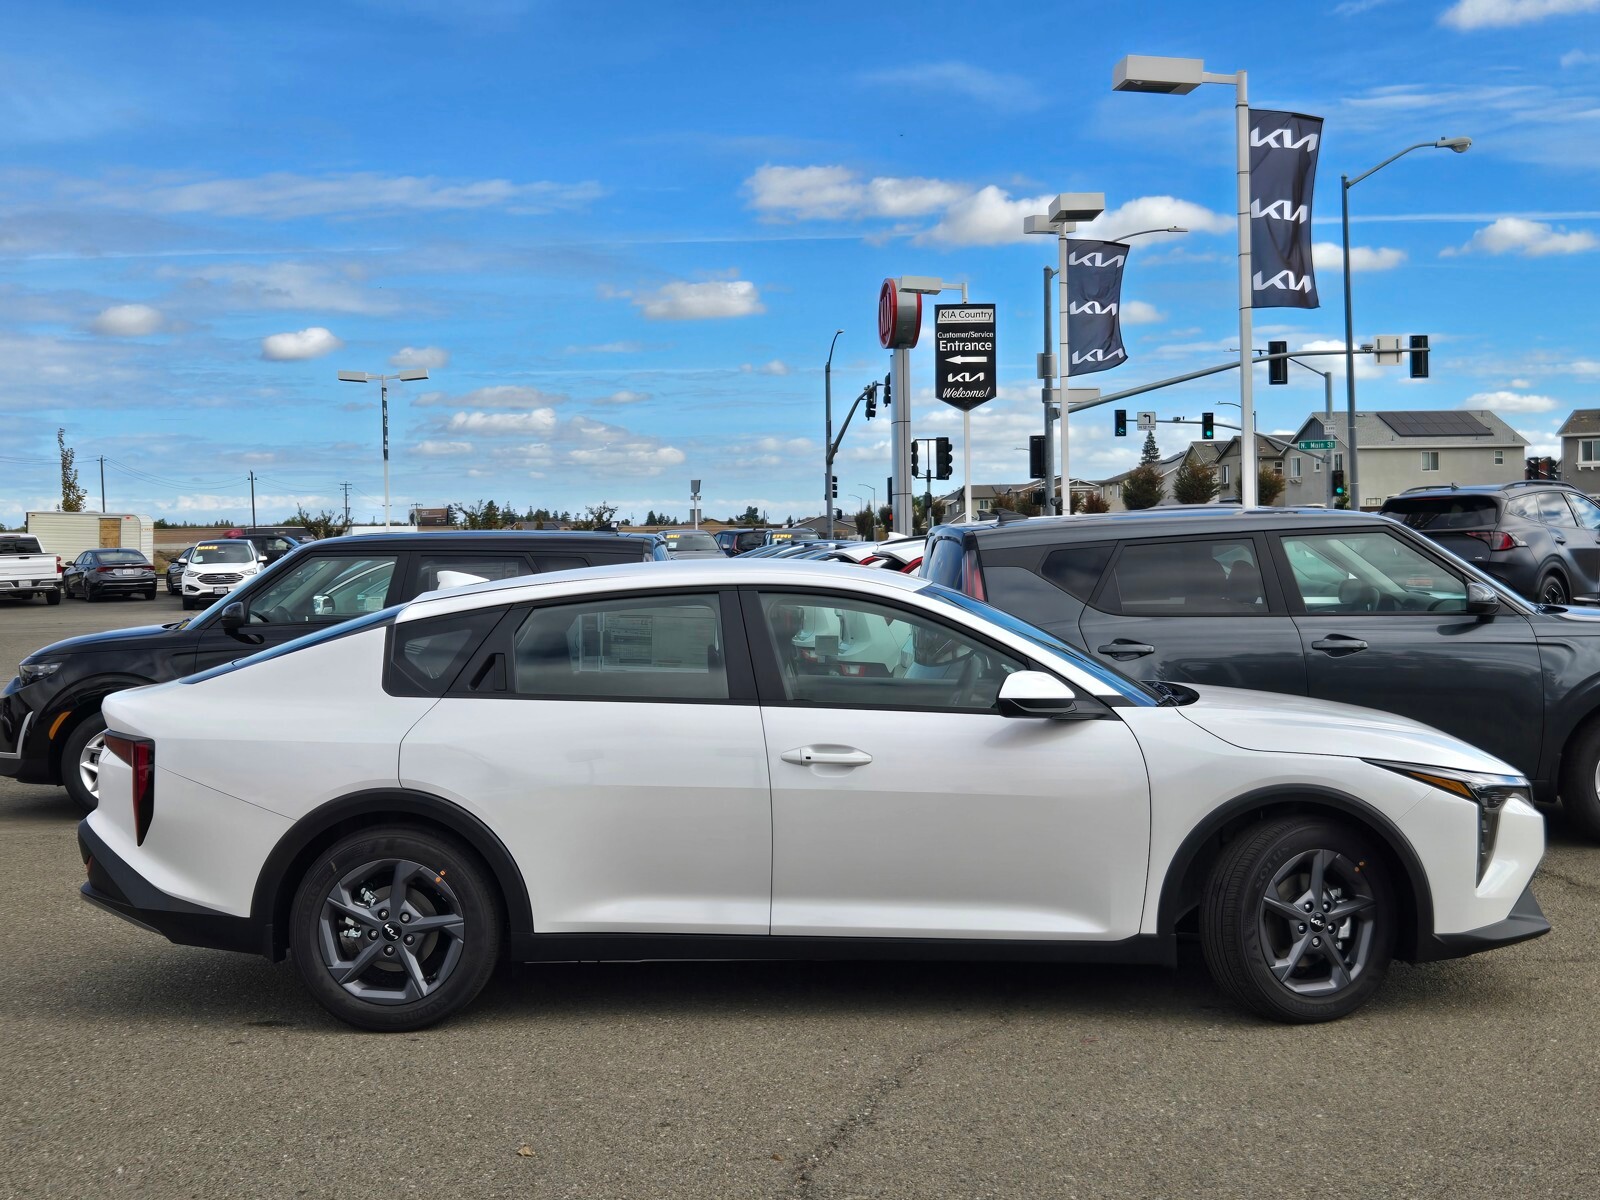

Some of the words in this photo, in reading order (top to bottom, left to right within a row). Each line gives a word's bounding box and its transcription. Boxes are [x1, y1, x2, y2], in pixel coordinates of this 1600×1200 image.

[941, 311, 957, 319] KIA
[959, 310, 993, 320] Country
[937, 331, 994, 339] Customer/Service
[939, 340, 993, 351] Entrance
[942, 387, 991, 398] Welcome!
